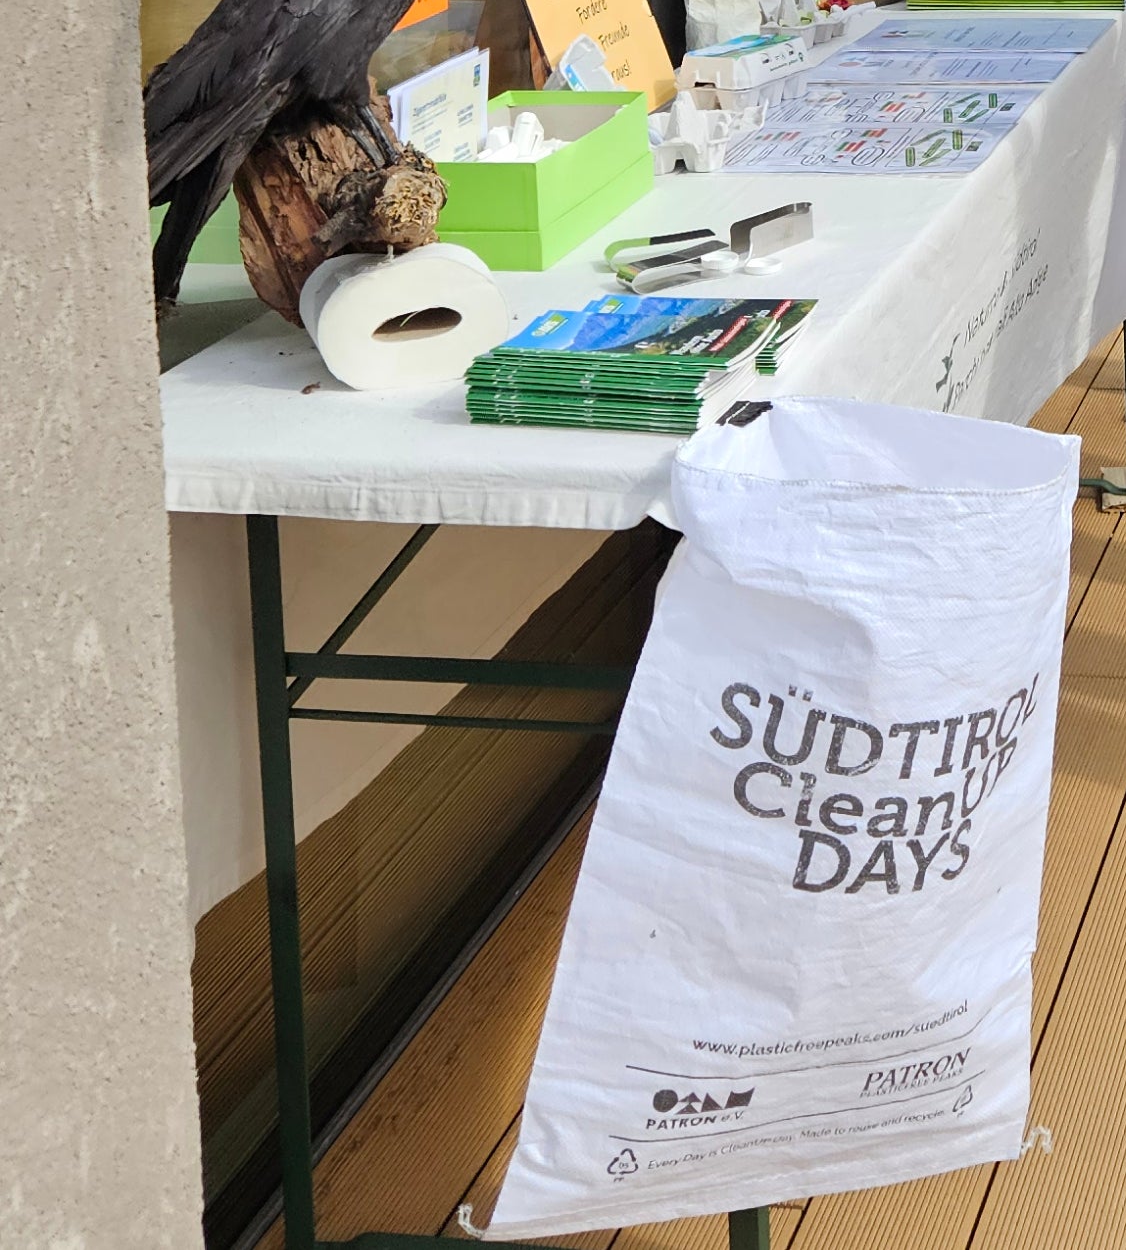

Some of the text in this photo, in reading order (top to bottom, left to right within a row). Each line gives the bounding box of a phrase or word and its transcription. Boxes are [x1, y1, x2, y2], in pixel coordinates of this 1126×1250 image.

[598, 23, 631, 52] Freunde
[709, 672, 1040, 779] SÜDTIROL
[733, 736, 1018, 839] CleanUP
[792, 818, 972, 896] DAYS
[692, 1000, 969, 1058] www.plasticfreepeaks.com/suedtirol
[862, 1045, 972, 1092] PATRON
[645, 1114, 718, 1131] PATRON
[647, 1158, 680, 1171] Every
[682, 1152, 706, 1164] Day
[834, 1126, 847, 1136] to
